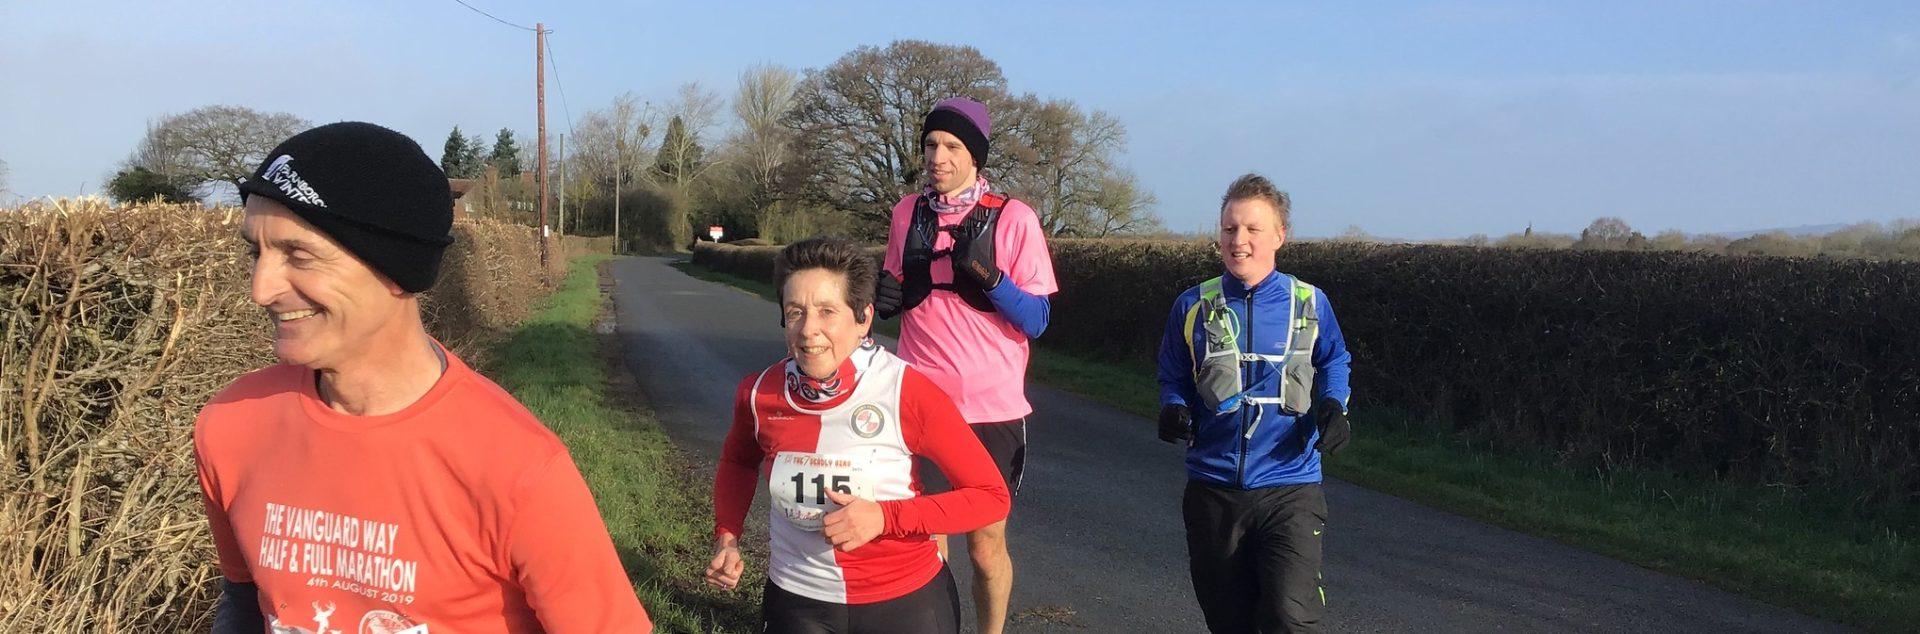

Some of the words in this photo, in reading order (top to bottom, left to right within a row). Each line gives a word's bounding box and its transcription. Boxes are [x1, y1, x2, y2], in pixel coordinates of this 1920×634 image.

[280, 163, 327, 208] FARNBORO
[791, 472, 851, 505] 115
[264, 502, 285, 536] THE
[286, 506, 359, 548] VANGUARD
[363, 520, 398, 555] WAY
[258, 536, 288, 571] HALF
[288, 543, 299, 573] &
[302, 543, 333, 576] FULL
[335, 548, 417, 593] MARATHON
[306, 577, 329, 588] 4th
[331, 579, 379, 599] AUGUST
[380, 591, 415, 605] 2019
